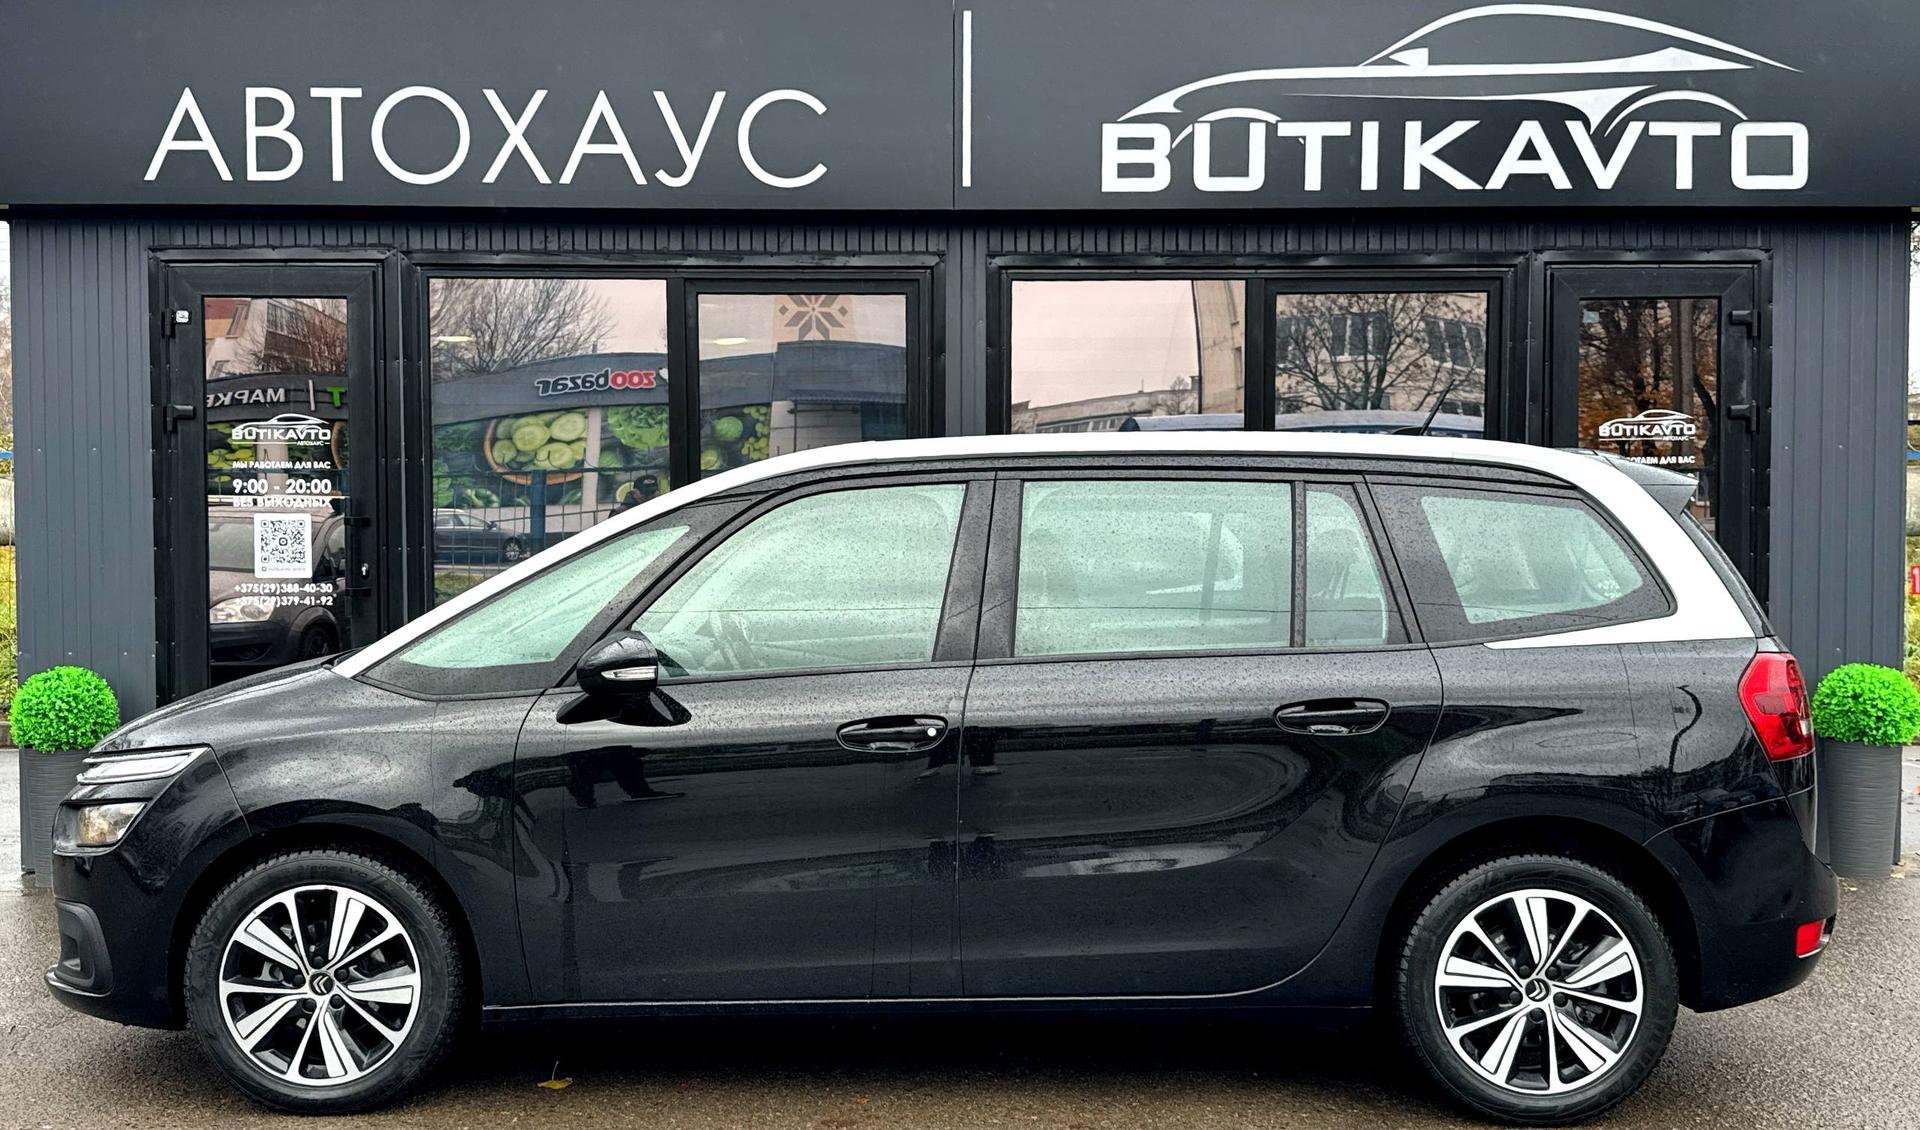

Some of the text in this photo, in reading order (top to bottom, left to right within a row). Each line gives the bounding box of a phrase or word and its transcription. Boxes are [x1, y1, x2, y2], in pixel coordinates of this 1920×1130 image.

[143, 85, 828, 188] АВТОХАУС
[1101, 119, 1809, 193] BUTIKAVTO
[231, 428, 332, 440] BUTIKAVTO
[1598, 423, 1696, 437] BUTIKAVTO
[232, 461, 332, 469] МЫ РАБОТАЕМ ДЛЯ ВАС
[1659, 456, 1677, 464] ДЛЯ
[1678, 456, 1696, 464] ВАС
[232, 479, 268, 494] 9:00
[285, 478, 332, 494] 20:00
[257, 496, 332, 509] ВЫХОДНЫХ
[234, 583, 333, 595] +375(29)388-40-30
